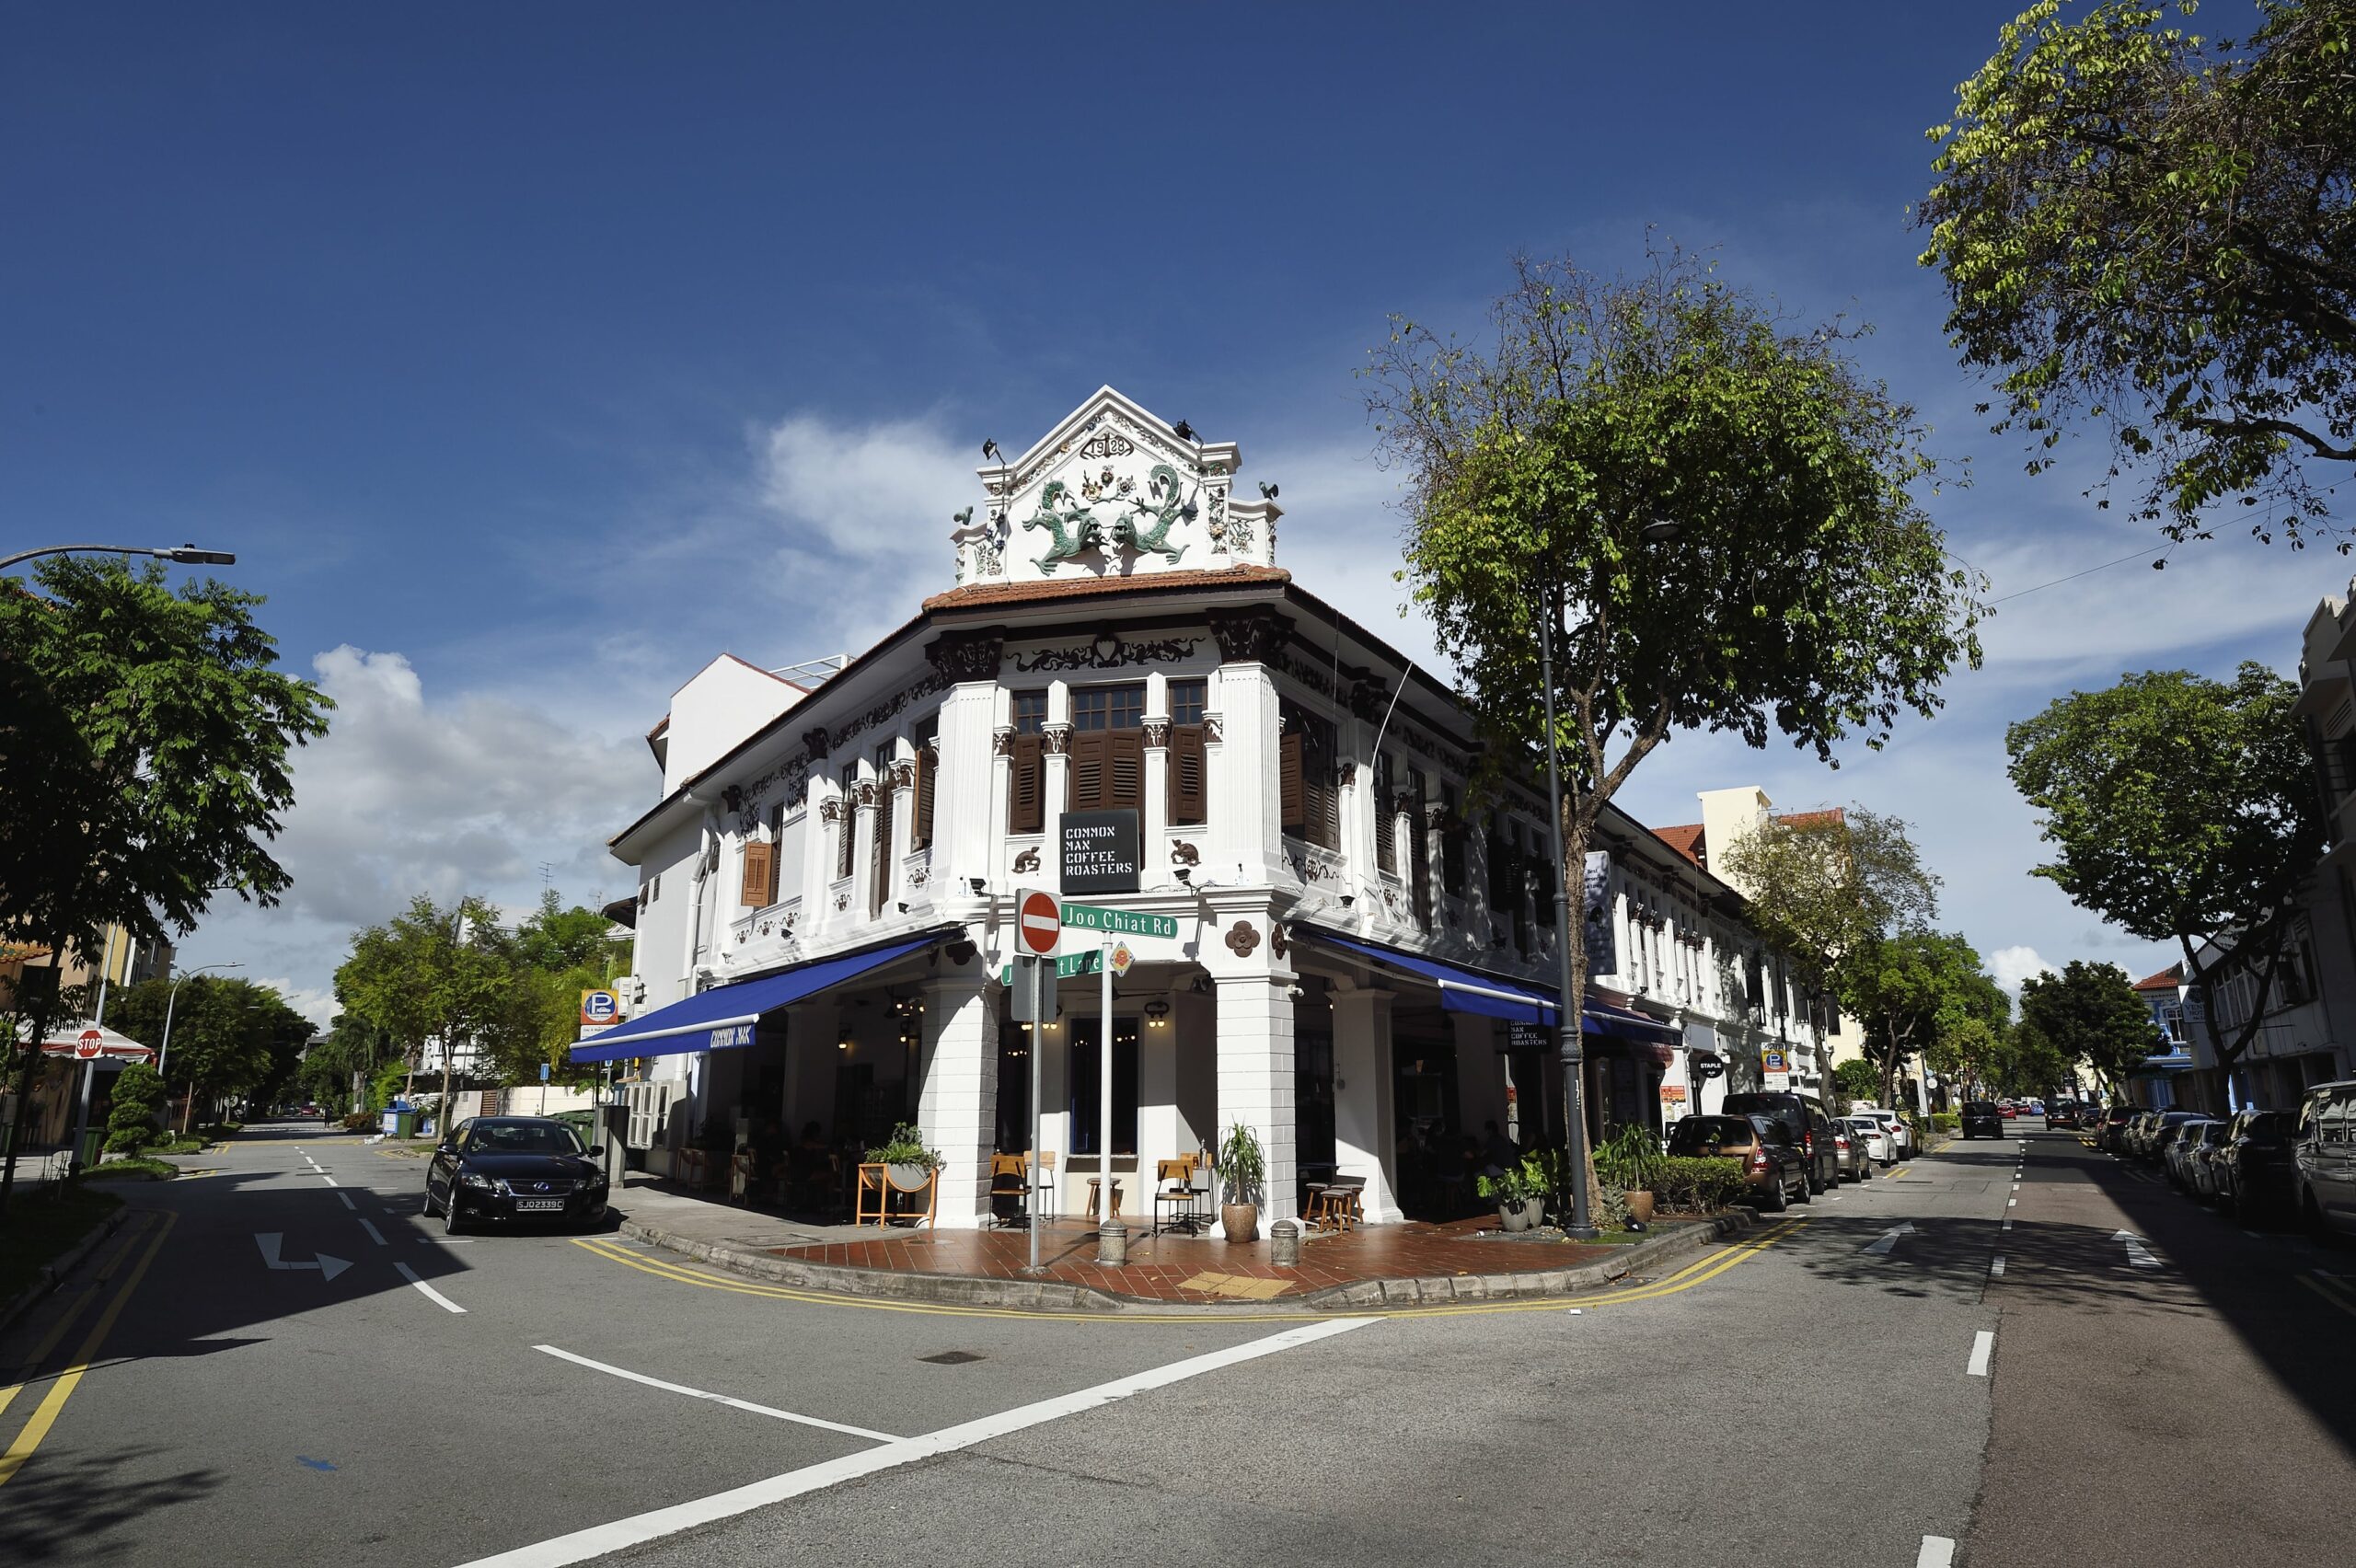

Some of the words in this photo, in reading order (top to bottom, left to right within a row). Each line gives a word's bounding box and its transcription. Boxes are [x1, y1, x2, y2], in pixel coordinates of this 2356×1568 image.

[1066, 826, 1115, 839] COMMON
[1066, 840, 1091, 851] MAN
[1066, 850, 1115, 864] COFFEE
[1066, 862, 1133, 877] ROASTERS
[1068, 907, 1095, 926] Joo
[1103, 911, 1147, 933] Chiat
[1153, 917, 1172, 935] Rd
[1069, 956, 1101, 974] Lane
[77, 1037, 101, 1050] STOP
